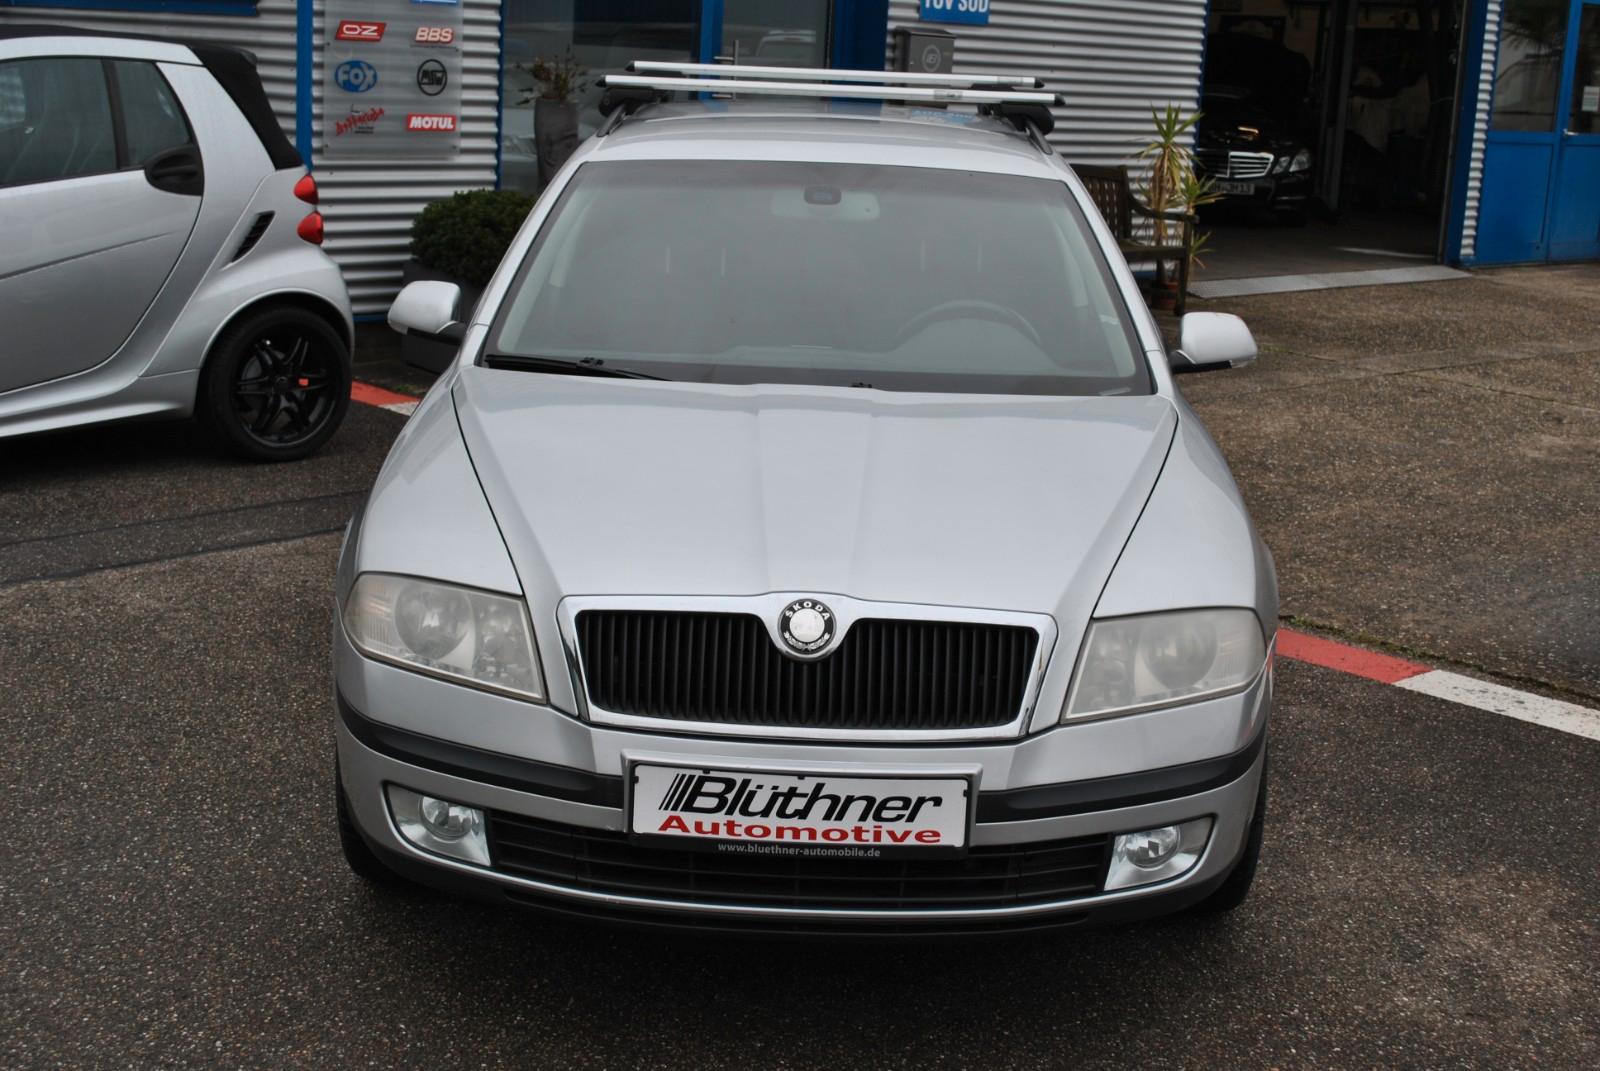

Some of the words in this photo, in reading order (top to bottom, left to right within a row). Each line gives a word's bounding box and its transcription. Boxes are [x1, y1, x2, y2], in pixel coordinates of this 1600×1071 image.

[342, 24, 379, 36] OZ
[415, 27, 453, 43] BBS
[409, 116, 454, 130] MOTUL
[680, 774, 943, 823] Blüthner
[658, 814, 942, 844] Automotive
[717, 842, 881, 858] www.bluethner-automobile.de
